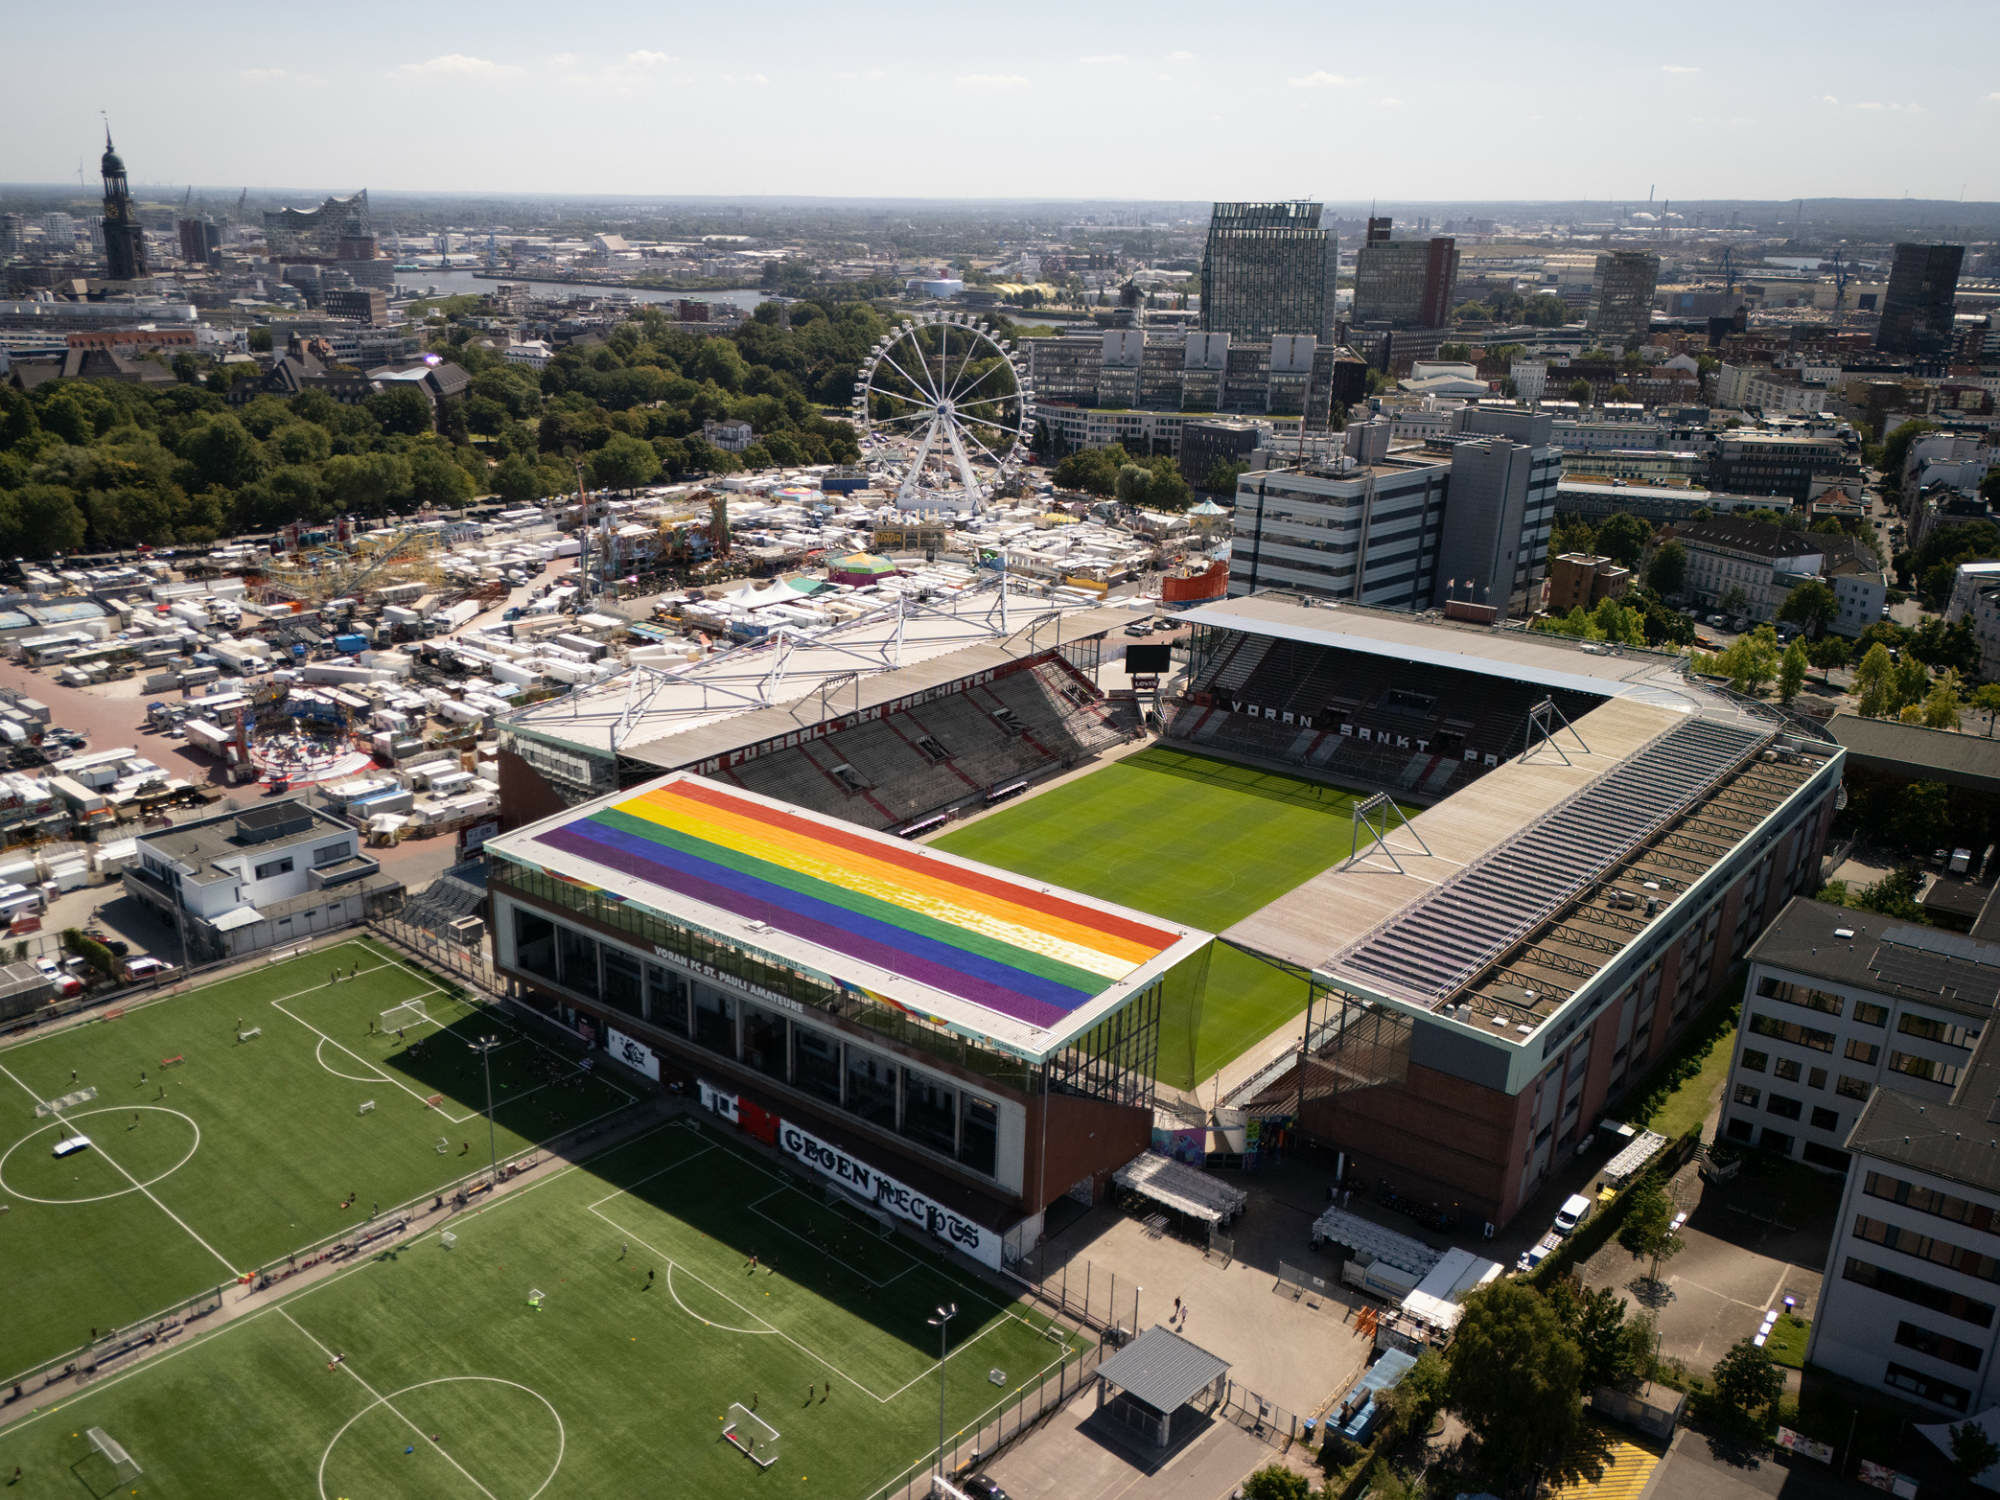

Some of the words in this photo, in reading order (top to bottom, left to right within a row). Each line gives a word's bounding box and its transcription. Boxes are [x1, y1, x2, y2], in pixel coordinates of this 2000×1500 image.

[730, 722, 837, 766] FUSSBALL
[845, 706, 881, 729] DEN
[889, 670, 994, 714] FASCHISTEN
[1232, 701, 1312, 728] VORAN
[1340, 723, 1429, 751] SANKT
[654, 945, 687, 967] VORAN
[690, 959, 701, 972] FC
[719, 971, 747, 991] PAULI
[751, 984, 804, 1013] AMATEURE
[785, 1129, 870, 1190] GEGEN
